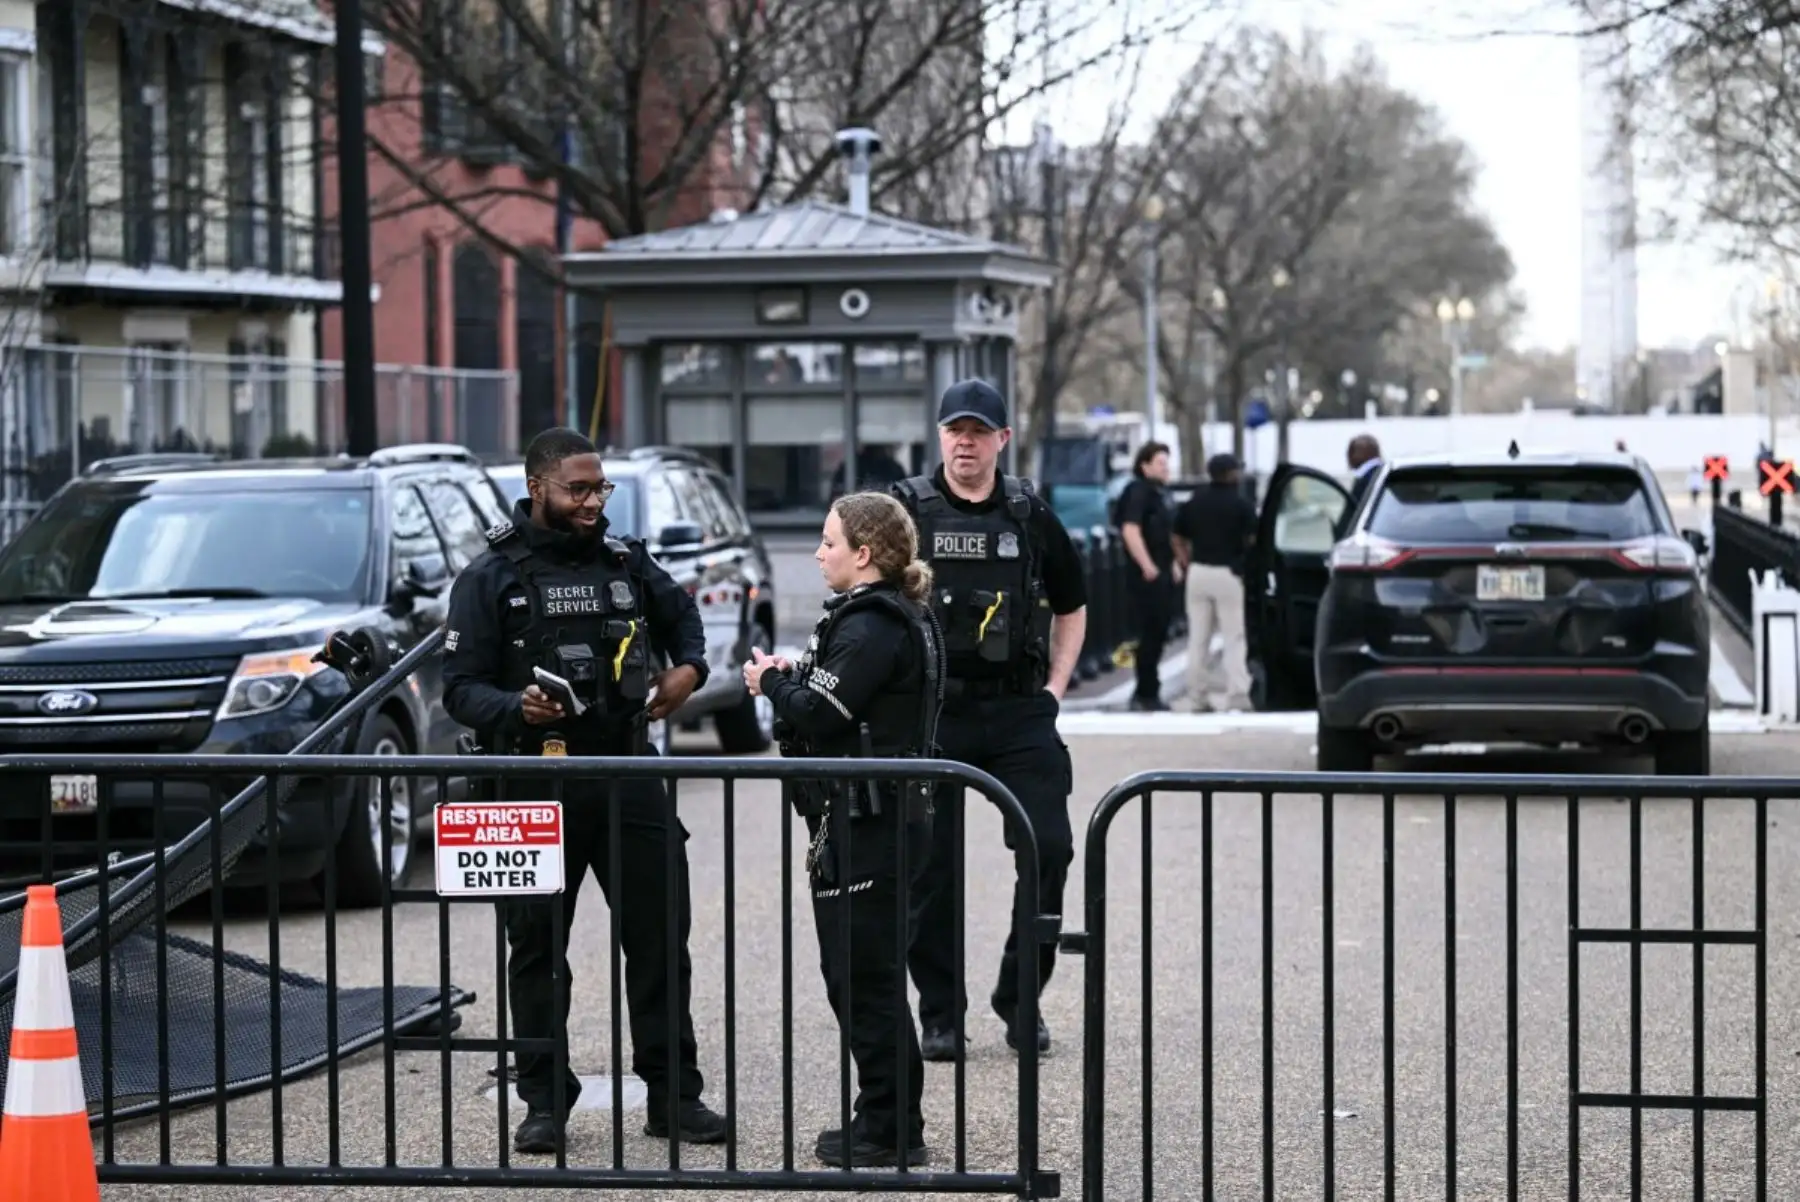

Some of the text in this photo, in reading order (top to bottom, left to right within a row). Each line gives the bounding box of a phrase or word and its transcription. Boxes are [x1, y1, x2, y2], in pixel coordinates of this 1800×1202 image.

[934, 536, 986, 553] POLICE
[547, 585, 595, 599] SECRET
[546, 600, 601, 614] SERVICE
[441, 807, 556, 825] RESTRICTED
[473, 826, 524, 842] AREA
[457, 850, 541, 868] DO NOT
[464, 871, 537, 888] ENTER
